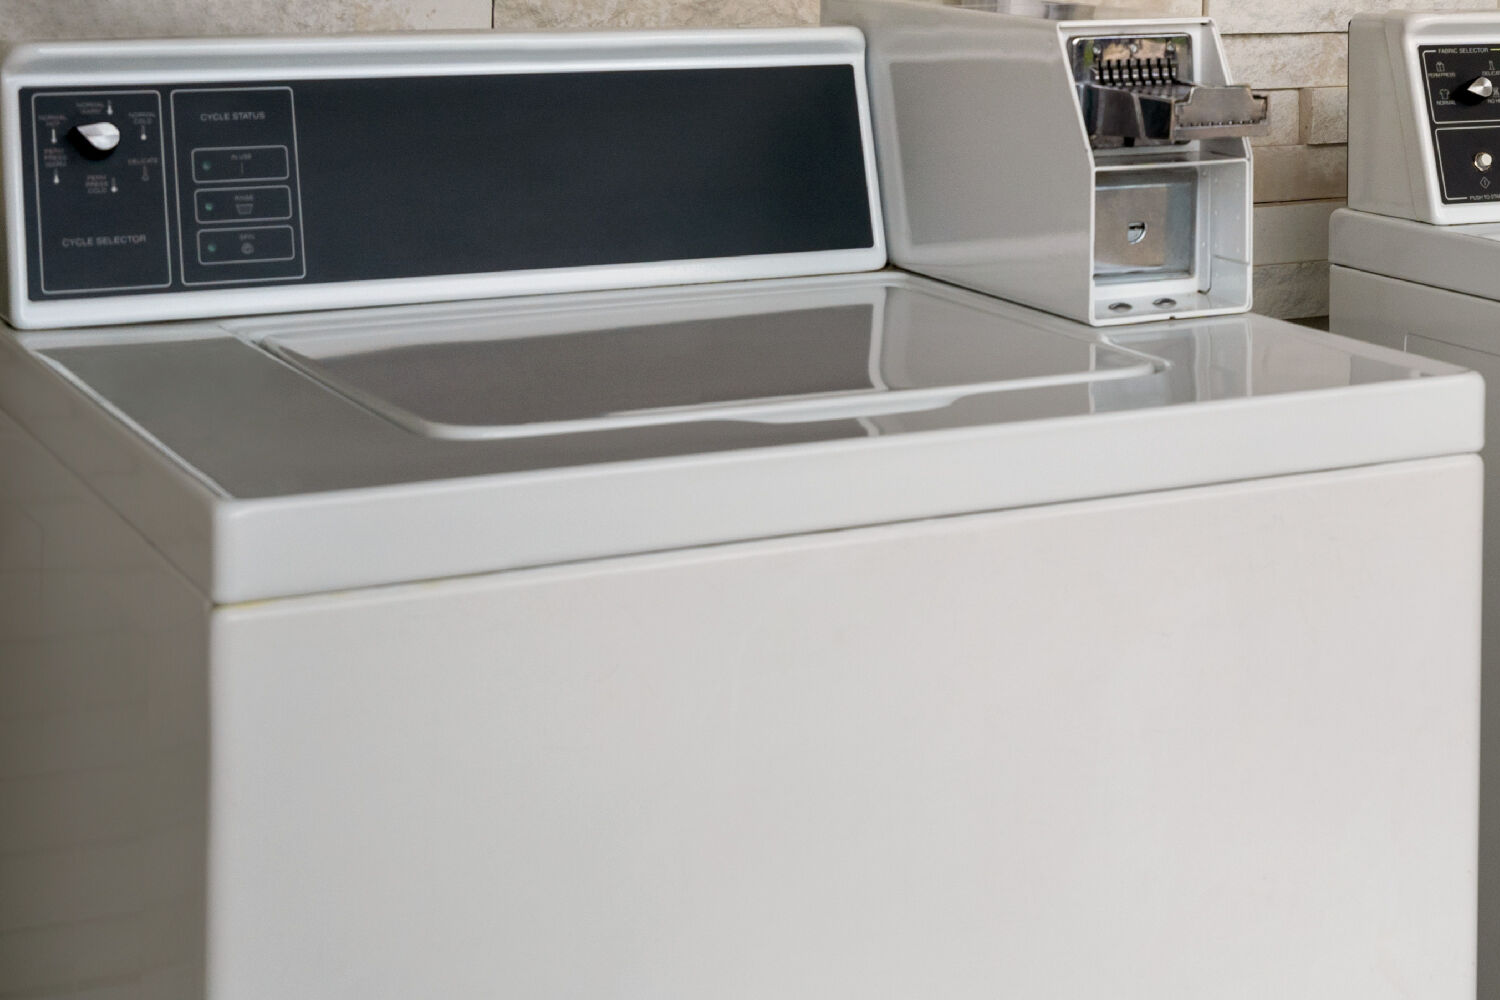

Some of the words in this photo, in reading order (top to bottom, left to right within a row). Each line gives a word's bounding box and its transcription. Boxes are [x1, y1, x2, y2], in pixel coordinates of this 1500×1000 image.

[200, 112, 230, 121] CYCLE
[232, 111, 266, 120] STATUS
[62, 237, 94, 248] CYCLE
[96, 234, 146, 245] SELECTOR
